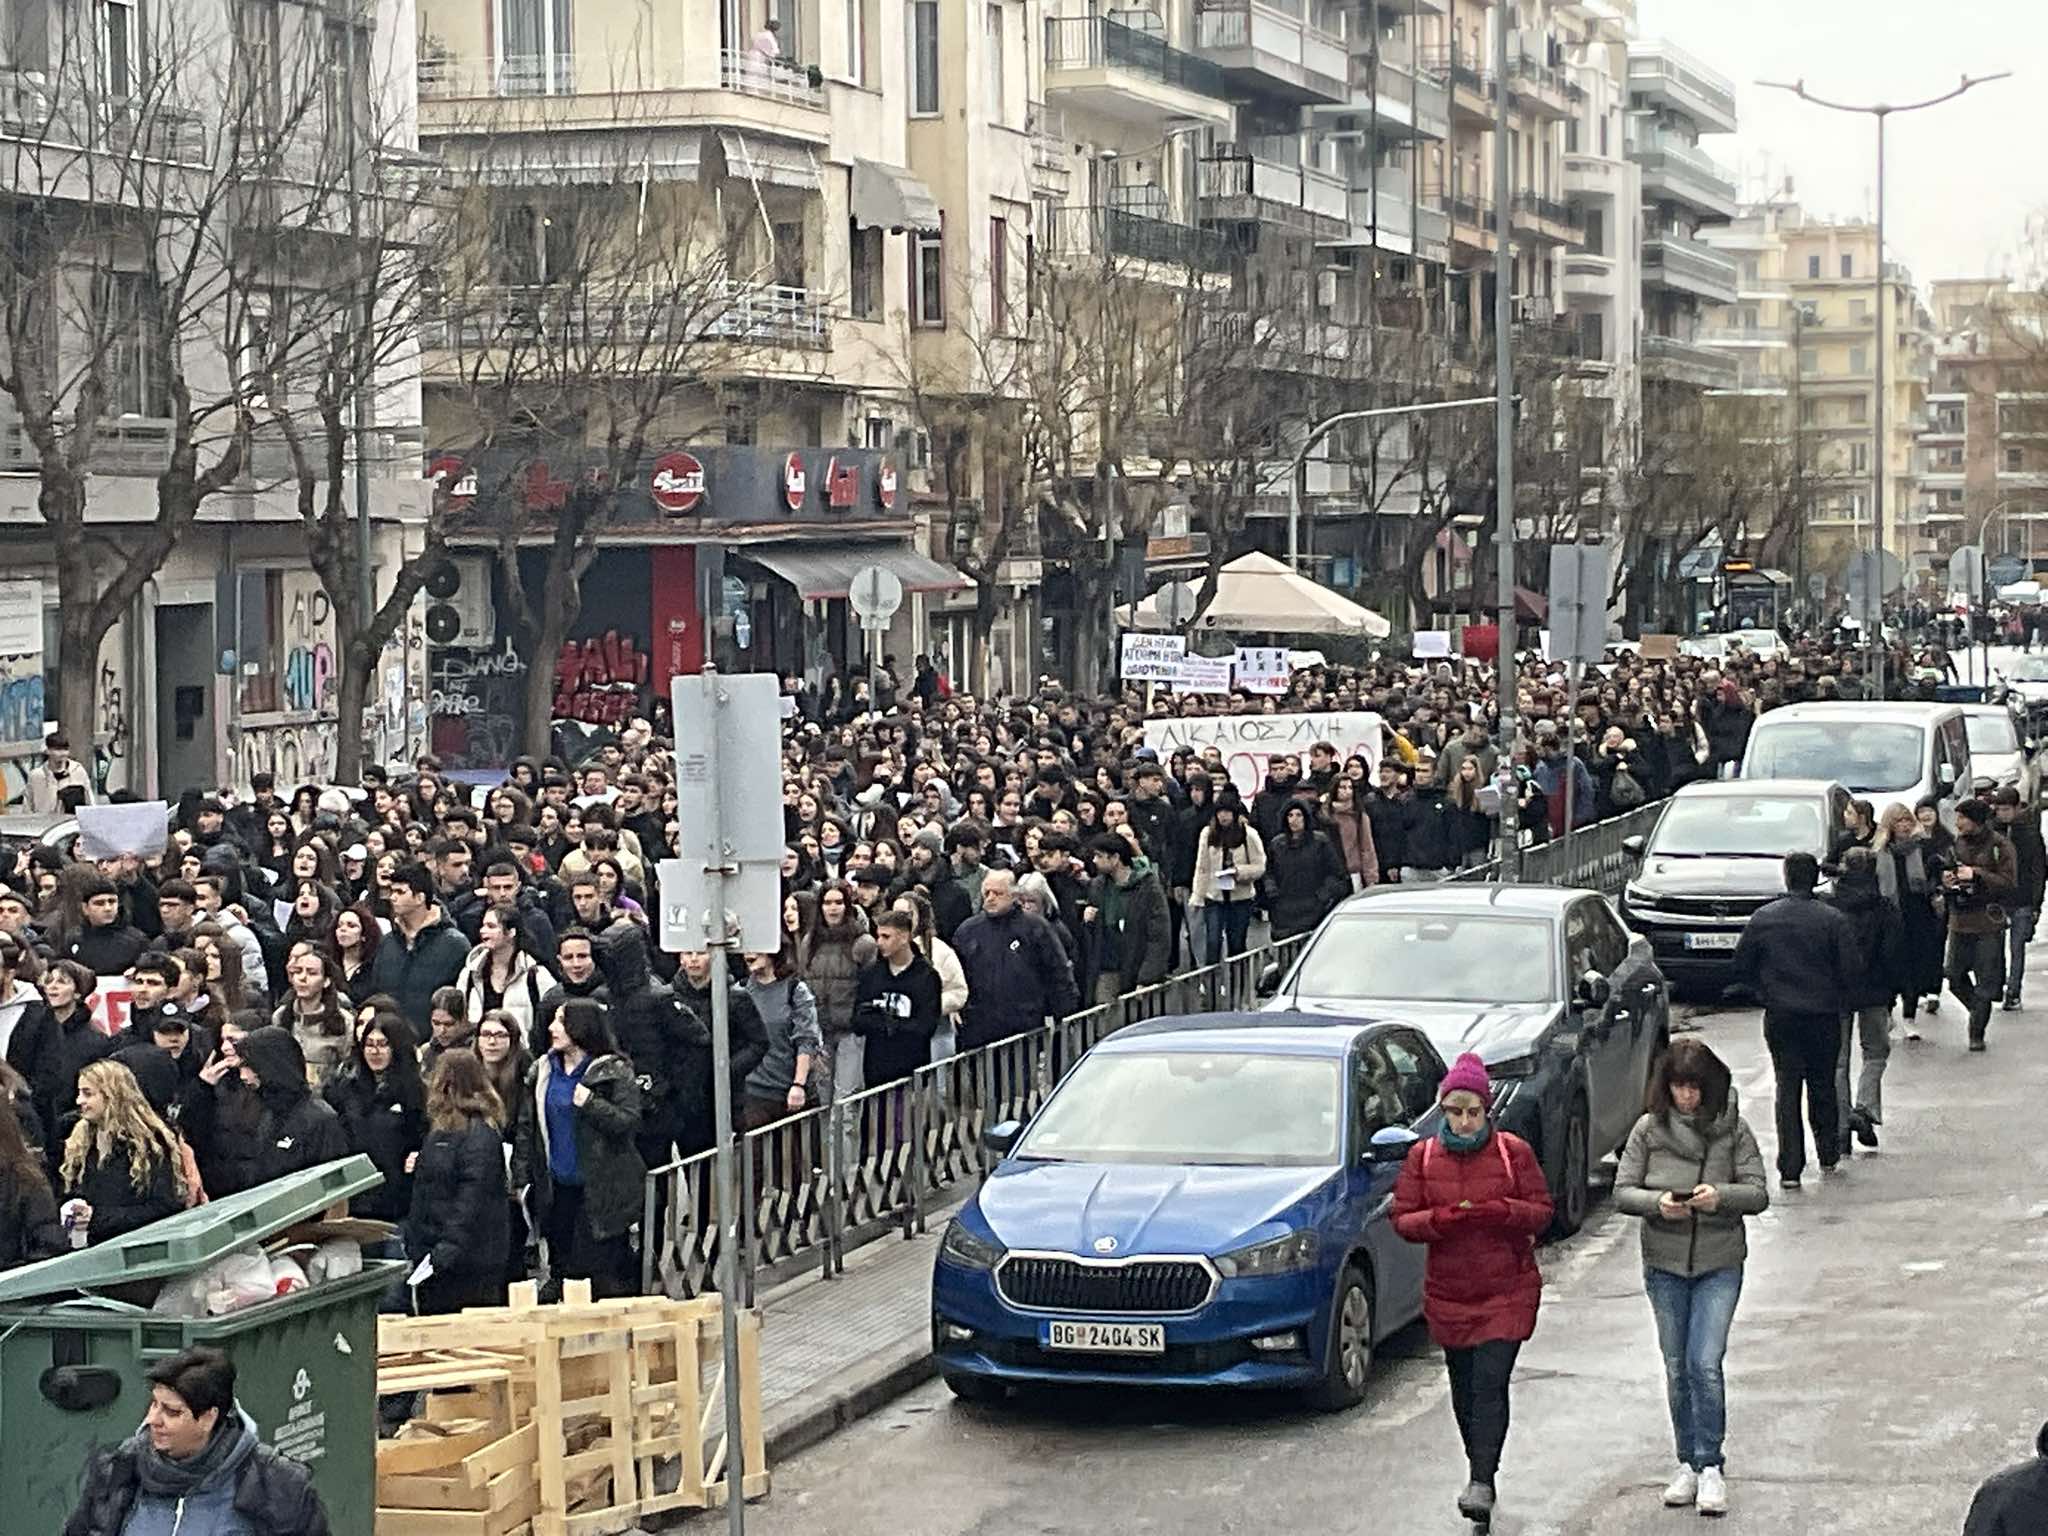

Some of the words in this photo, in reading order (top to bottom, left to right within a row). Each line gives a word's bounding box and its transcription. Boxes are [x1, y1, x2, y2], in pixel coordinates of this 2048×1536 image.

[1159, 717, 1344, 752] ΔΙΚΑΙΟΣΥΝΗ
[1053, 1324, 1074, 1344] BG
[1089, 1326, 1132, 1346] 2404
[1138, 1327, 1160, 1346] SK
